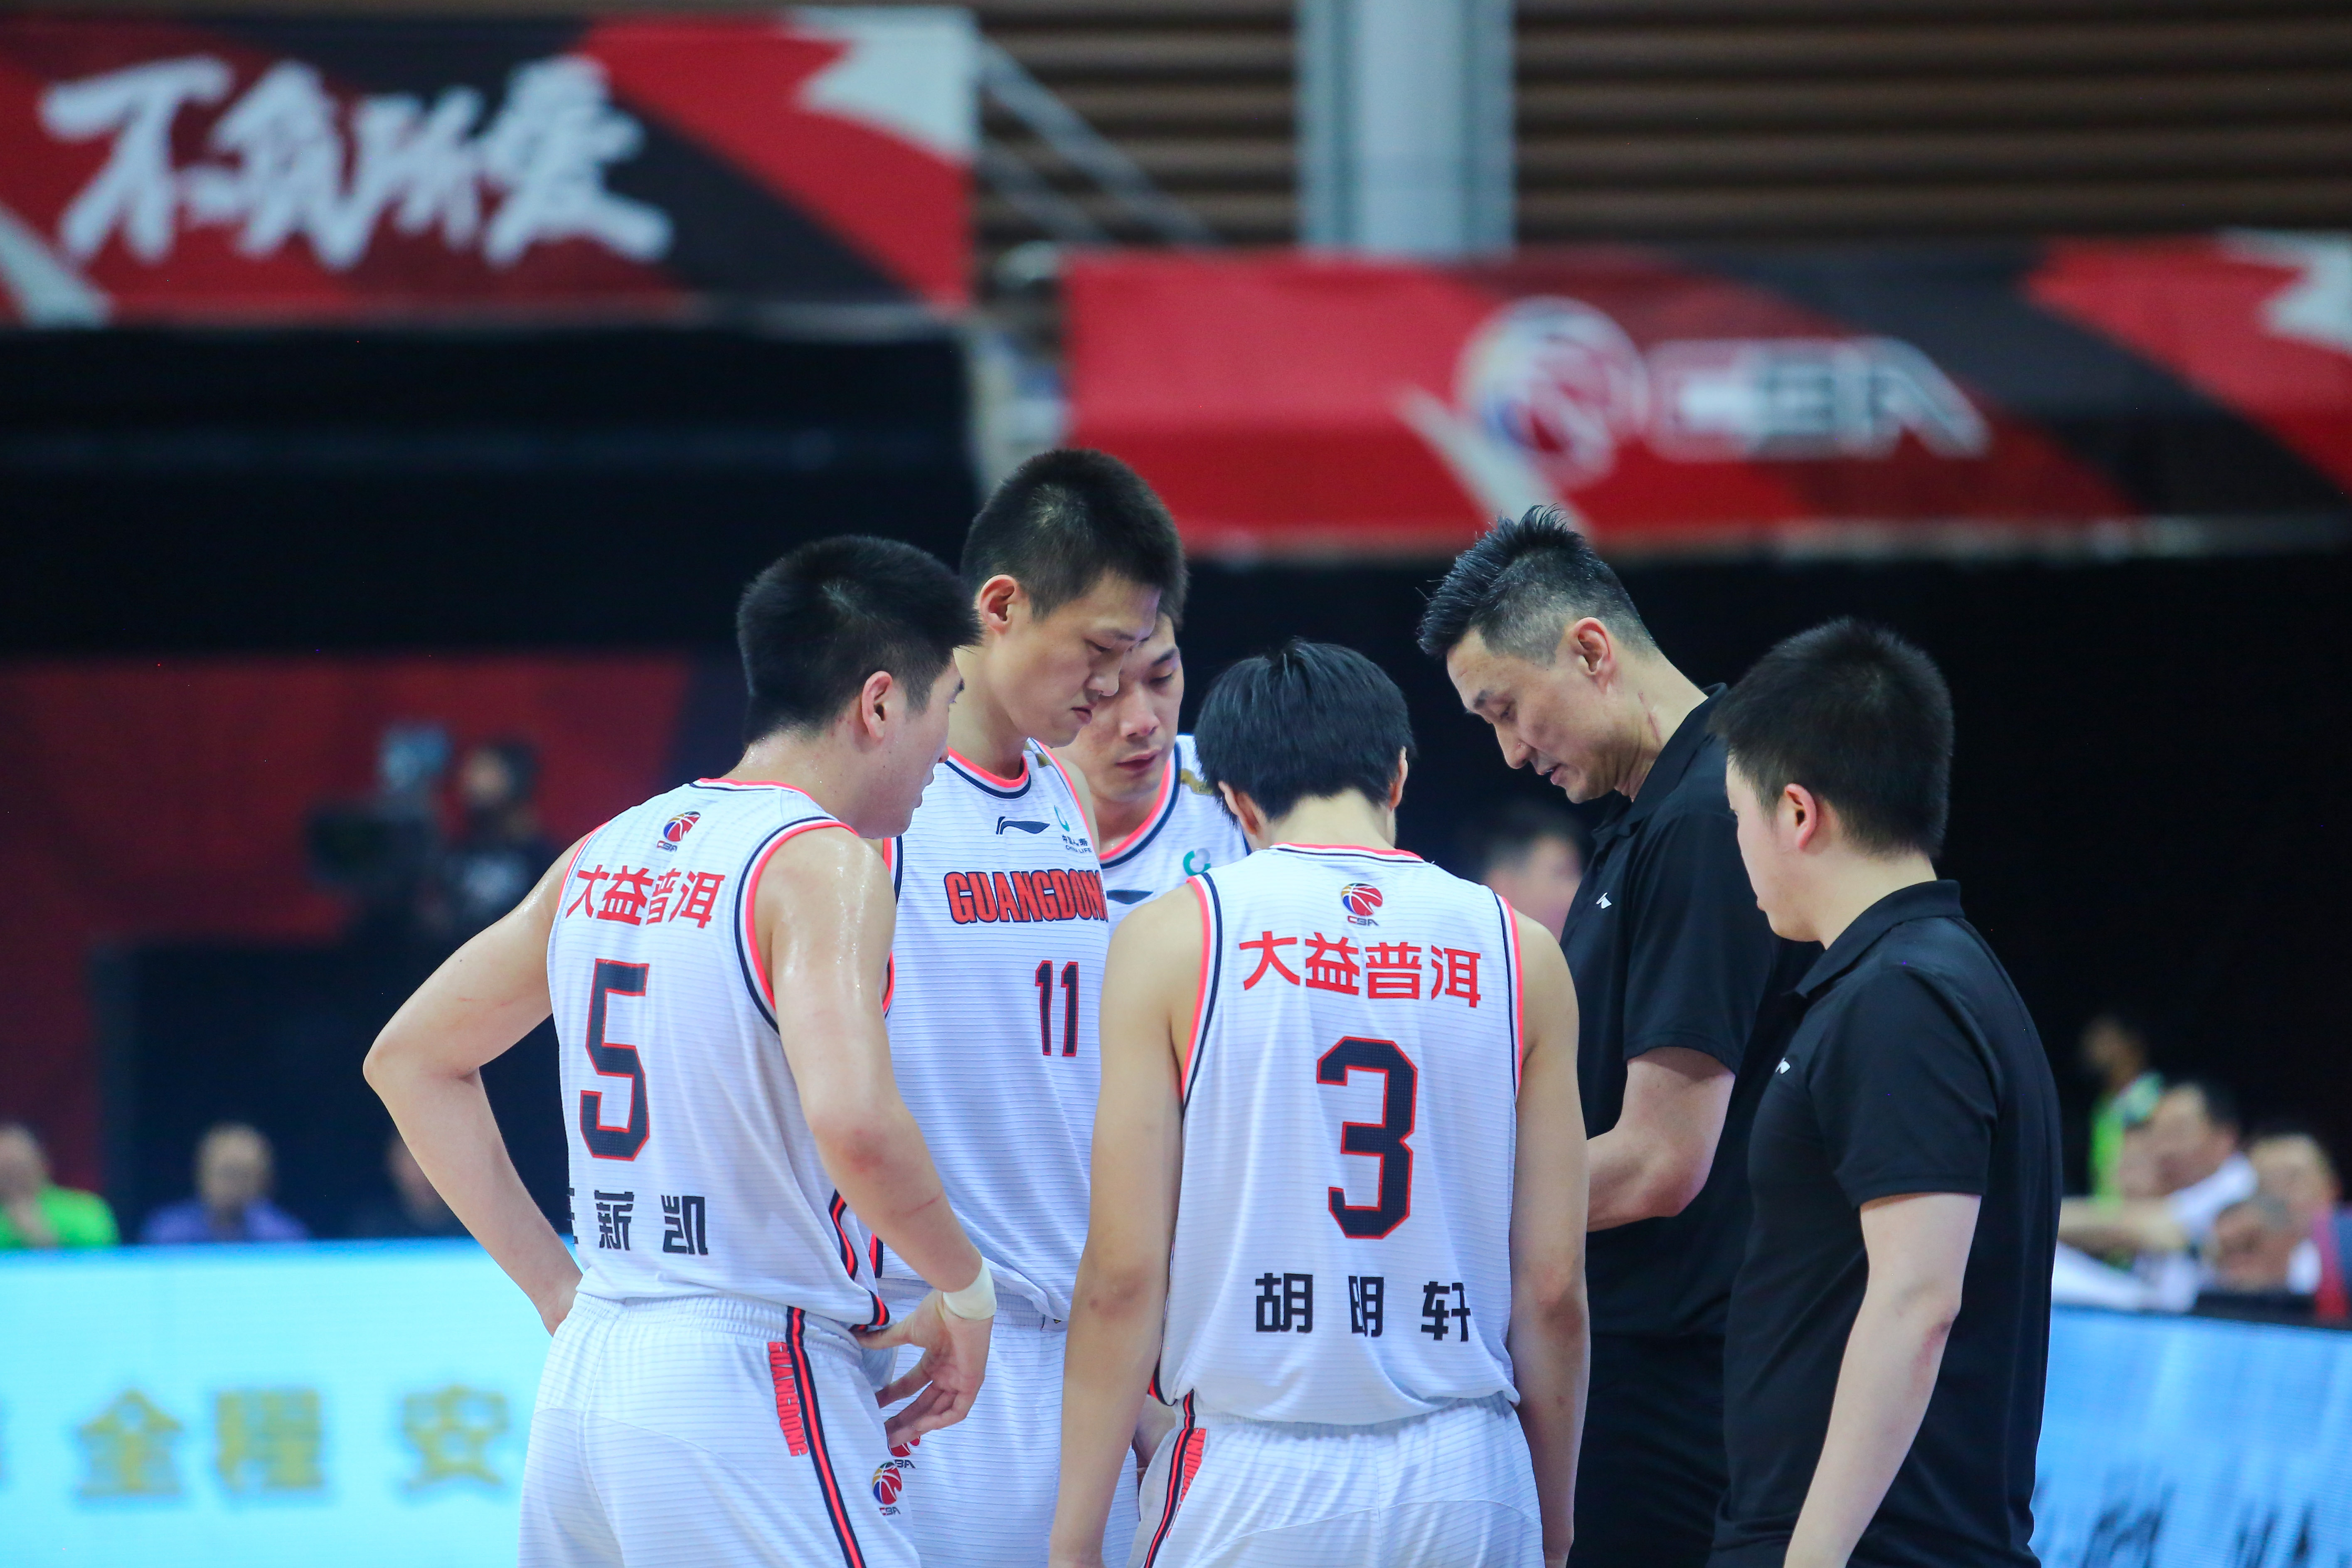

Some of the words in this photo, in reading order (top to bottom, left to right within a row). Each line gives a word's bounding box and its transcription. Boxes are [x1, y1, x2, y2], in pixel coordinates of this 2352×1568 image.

[657, 840, 677, 852] CBA
[566, 864, 725, 928] 大益普洱
[944, 868, 1109, 923] GUANGDON
[1347, 916, 1379, 926] CBA
[1239, 931, 1481, 1008] 大益普洱
[1035, 960, 1079, 1057] 11
[580, 958, 650, 1161] 5
[1316, 1036, 1418, 1239] 3
[569, 1188, 708, 1255] 薪凯
[1255, 1273, 1471, 1342] 胡明轩
[768, 1342, 808, 1457] GUANGDONG
[894, 1459, 916, 1469] BA
[879, 1506, 901, 1516] CBA
